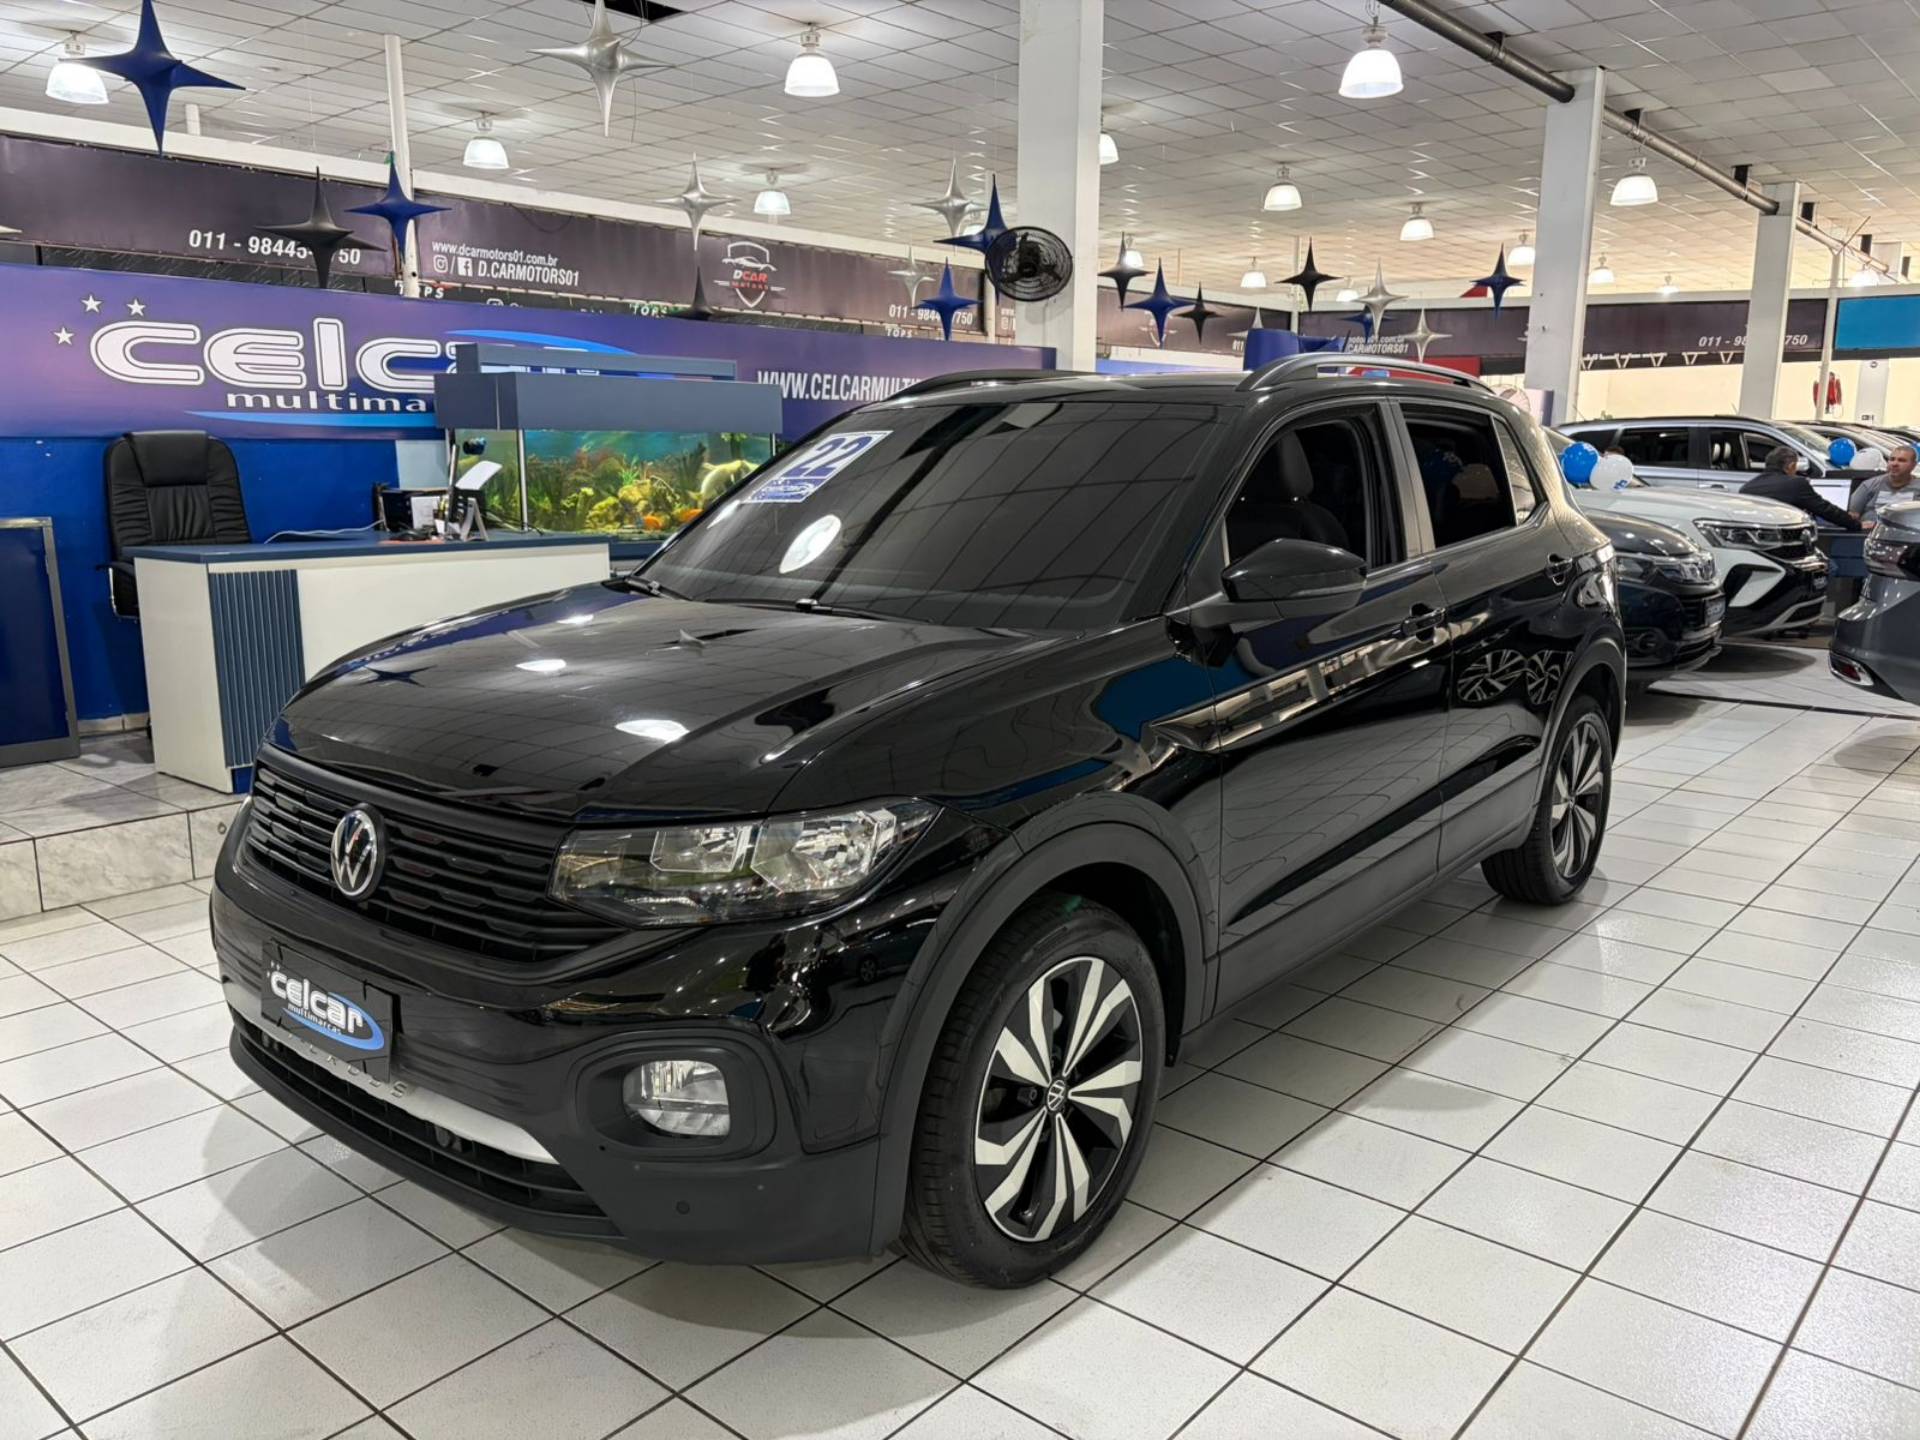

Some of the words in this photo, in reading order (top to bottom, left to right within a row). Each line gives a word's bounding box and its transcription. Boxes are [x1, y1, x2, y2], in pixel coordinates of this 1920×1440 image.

[189, 229, 226, 250] 011
[248, 236, 361, 265] 98445-50
[432, 240, 558, 266] www.dcarmotors01.com.br
[478, 261, 580, 287] D.CARMOTORS01
[733, 270, 768, 283] DCAR
[889, 305, 908, 319] 011
[1698, 336, 1722, 347] 011
[227, 390, 428, 412] multima
[780, 436, 873, 478] 22
[270, 970, 364, 1034] celcar
